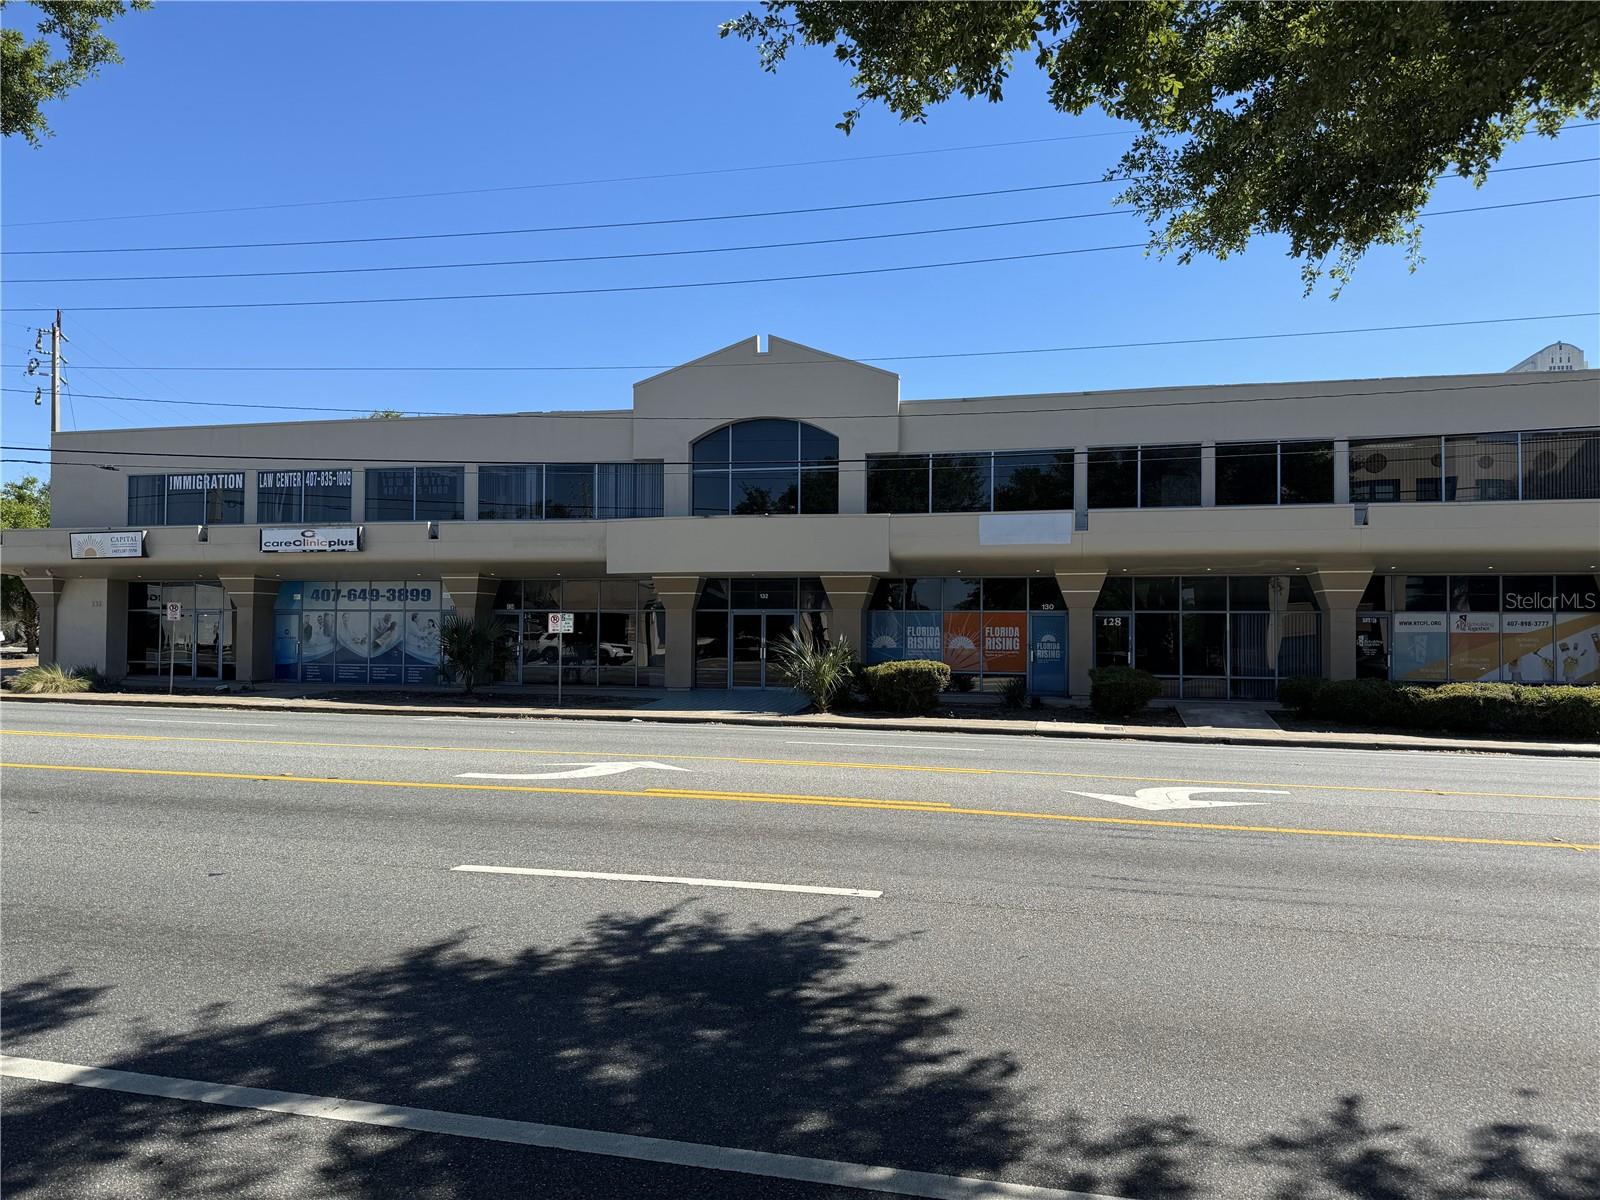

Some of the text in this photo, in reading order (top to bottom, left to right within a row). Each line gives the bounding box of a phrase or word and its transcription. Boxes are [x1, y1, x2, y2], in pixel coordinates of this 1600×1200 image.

[169, 473, 243, 490] IMMIGRATION
[259, 472, 273, 488] LAW
[276, 471, 301, 488] CENTER
[110, 535, 138, 543] CAPITAL
[263, 538, 355, 548] careClinicplus
[310, 588, 432, 602] 407-649-3899
[1103, 617, 1122, 626] 128
[907, 626, 940, 637] FLORIDA
[985, 626, 1020, 637] FLORIDA
[907, 637, 940, 649] RISING
[985, 637, 1020, 650] RISING
[1036, 642, 1061, 650] FLORIDA
[1036, 650, 1061, 659] RISING
